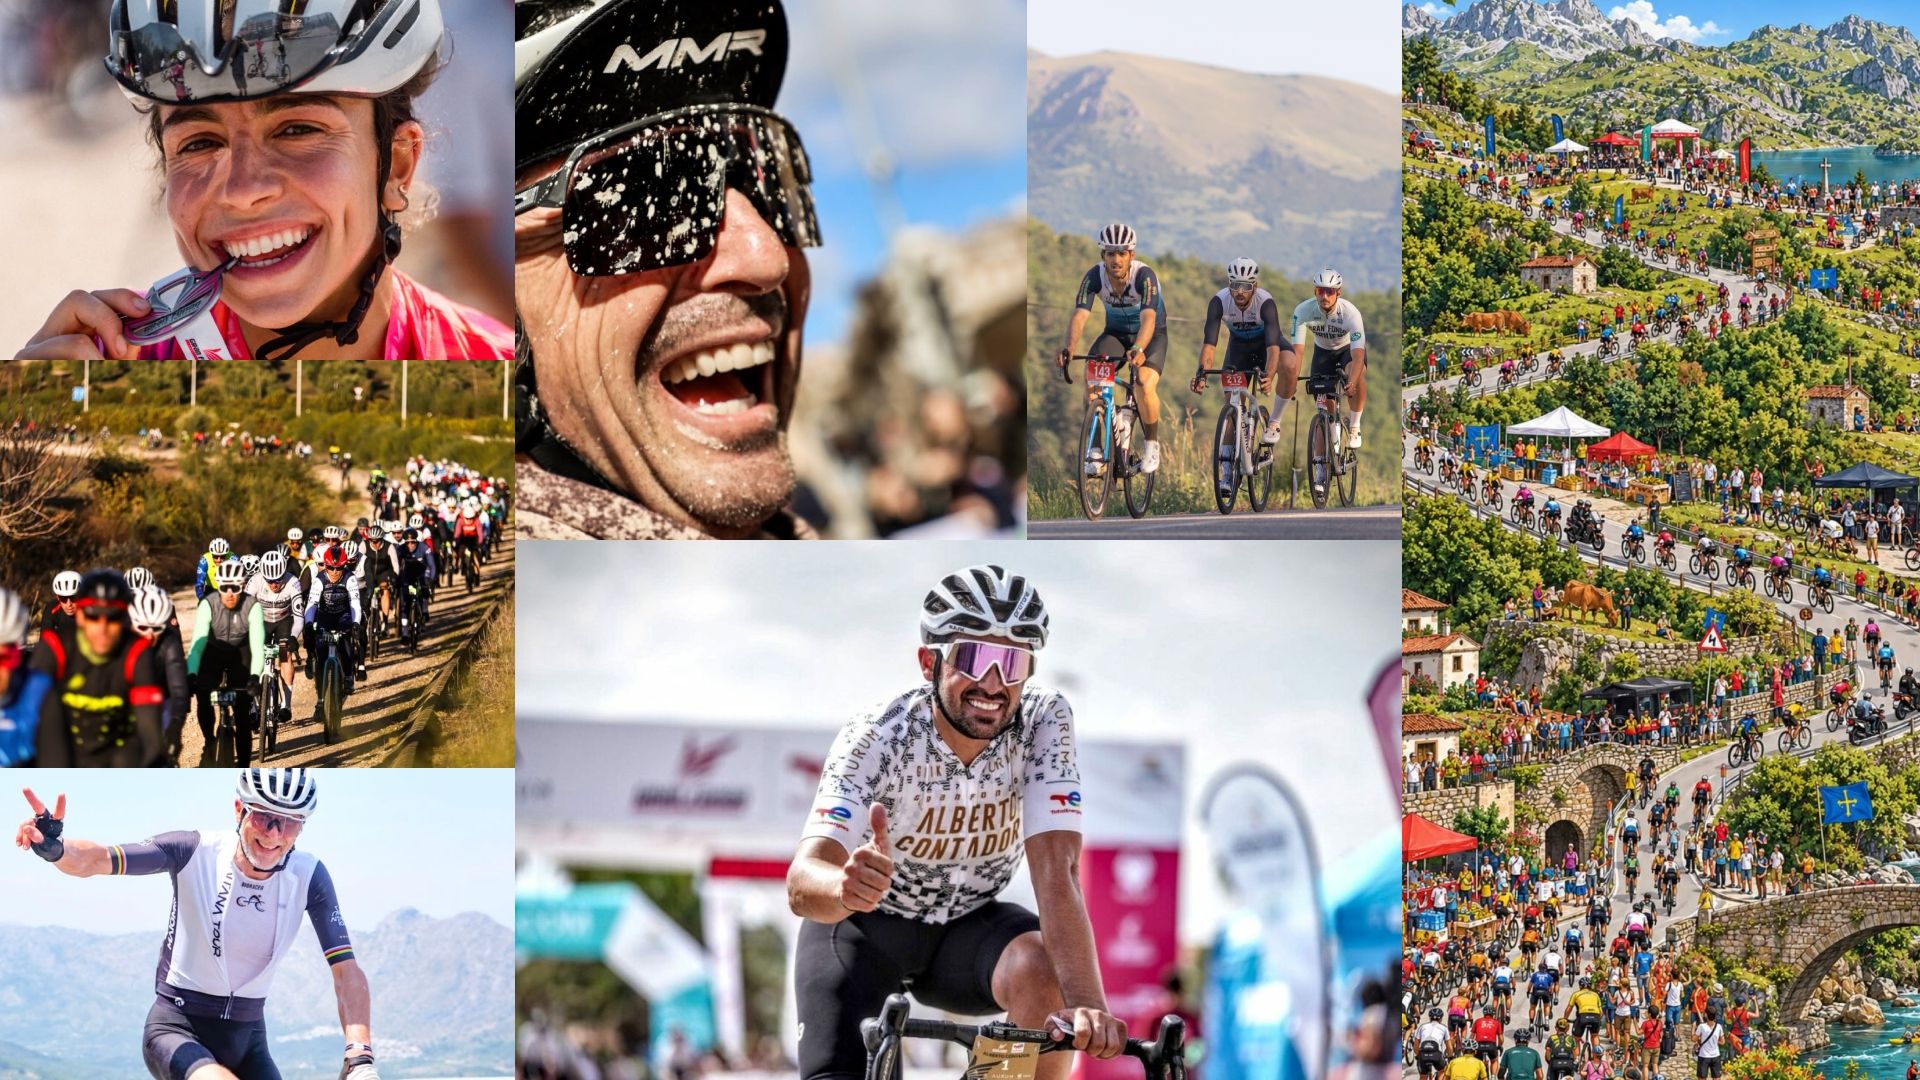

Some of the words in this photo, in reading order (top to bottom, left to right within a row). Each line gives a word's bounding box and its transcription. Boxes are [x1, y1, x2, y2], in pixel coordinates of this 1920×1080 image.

[603, 29, 766, 73] MMR
[1094, 366, 1111, 378] 143
[1227, 376, 1242, 384] 212
[1049, 700, 1071, 764] AURUM
[843, 729, 880, 784] AURUM
[916, 791, 1018, 835] ALBERTO
[895, 818, 1020, 860] CONTADOR
[212, 920, 222, 958] TOUR
[1001, 1059, 1009, 1070] 1
